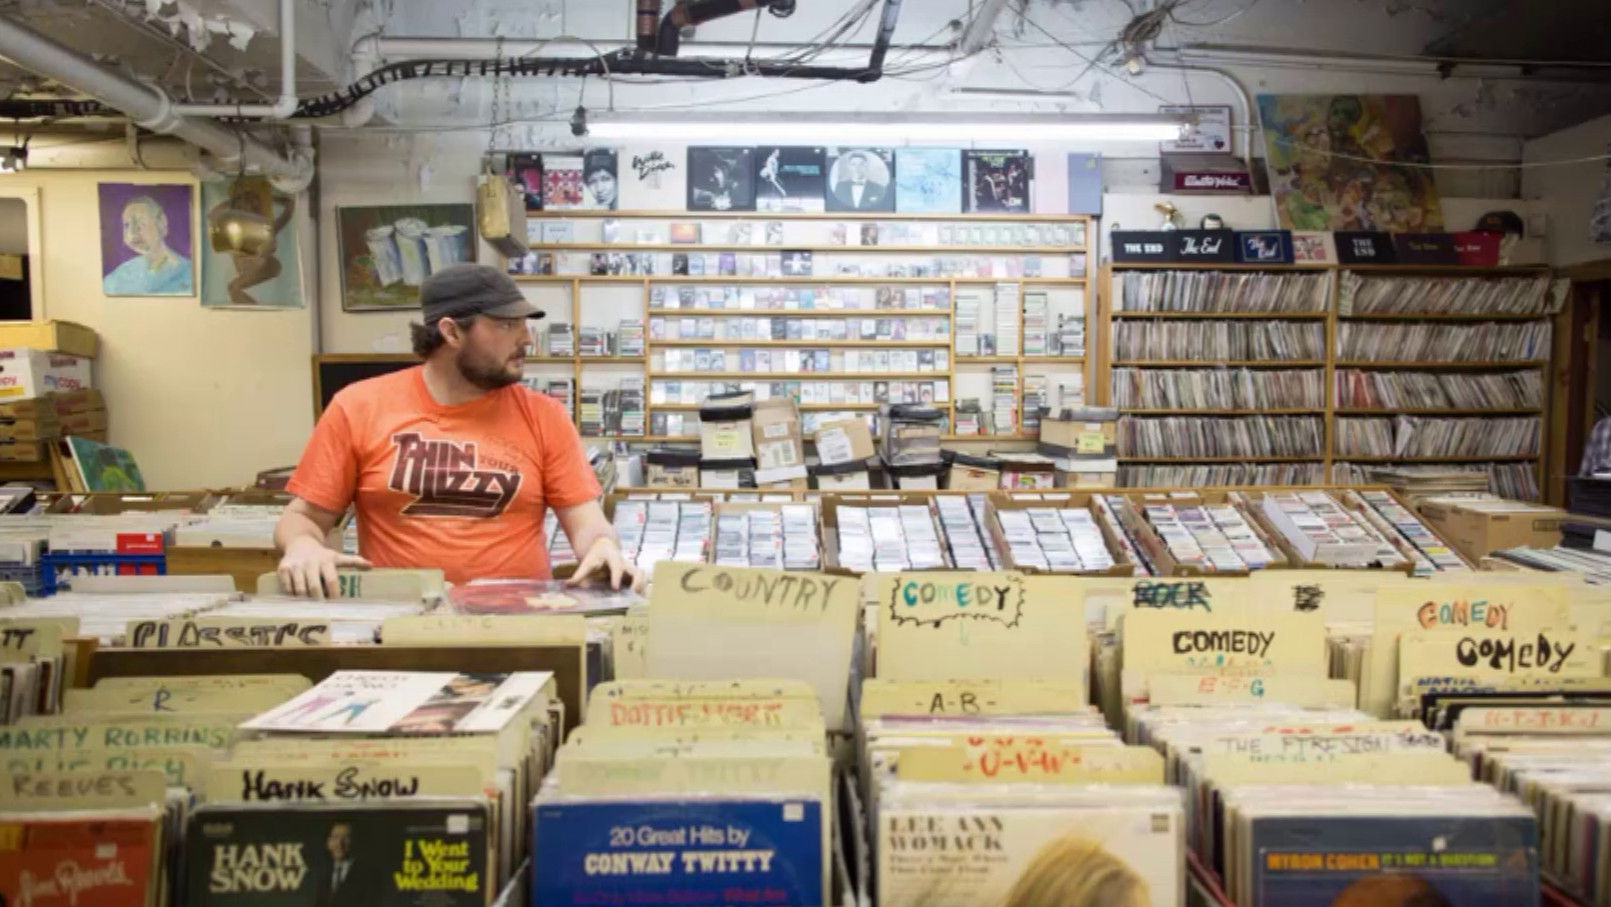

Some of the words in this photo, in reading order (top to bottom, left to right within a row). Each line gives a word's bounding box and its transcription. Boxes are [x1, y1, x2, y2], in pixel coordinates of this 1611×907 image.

[1124, 243, 1142, 253] THE
[1180, 237, 1200, 255] The
[1201, 237, 1222, 254] End
[680, 567, 838, 612] COUNTRY
[1417, 601, 1512, 630] COMEDY
[1172, 630, 1275, 658] COMEDY
[418, 840, 469, 858] Went
[609, 827, 634, 847] 20
[637, 826, 686, 845] Great
[690, 826, 725, 845] Hits
[727, 825, 751, 849] by
[213, 843, 304, 870] HANK
[583, 852, 675, 875] CONWAY
[682, 851, 775, 874] TWITTY
[209, 867, 308, 893] SNOW
[394, 873, 480, 892] Wedding
